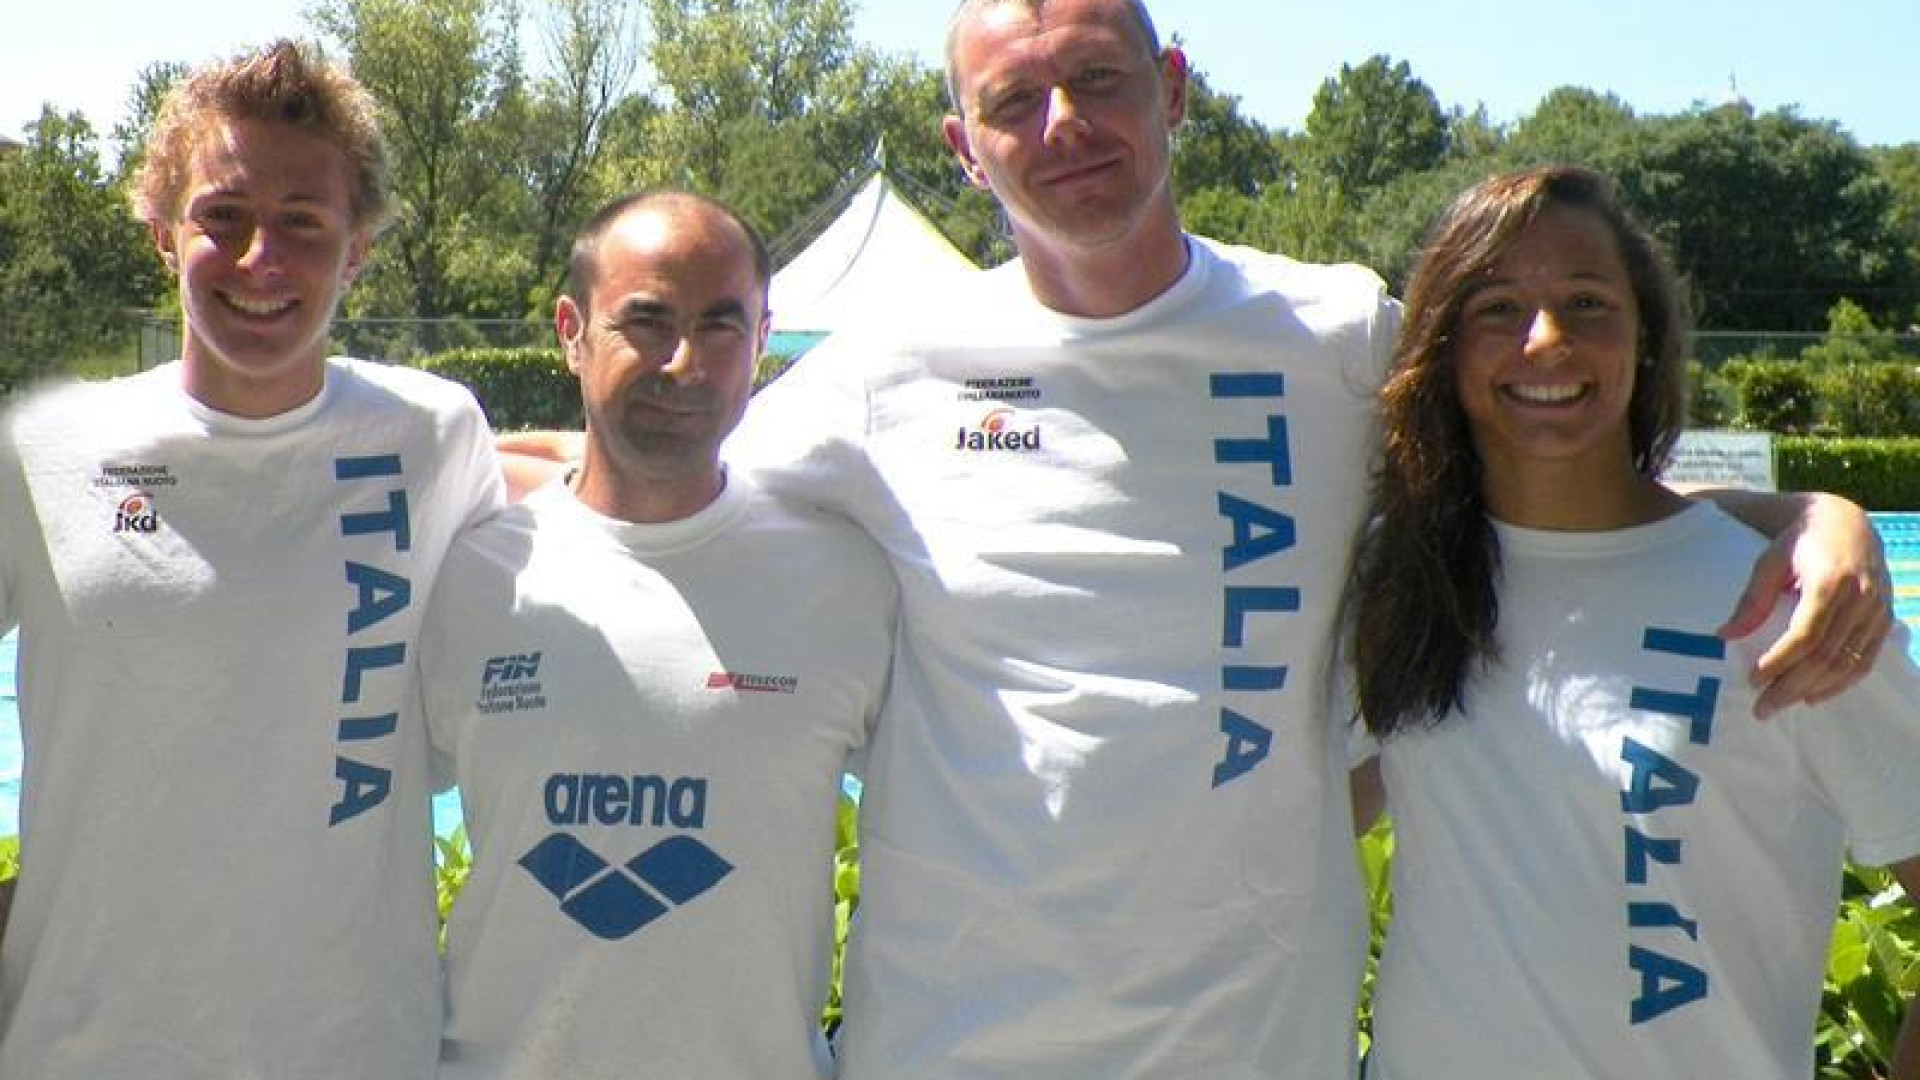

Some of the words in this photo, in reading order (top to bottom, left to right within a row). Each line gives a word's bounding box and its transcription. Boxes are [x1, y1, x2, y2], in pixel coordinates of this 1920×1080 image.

[955, 424, 1041, 452] Jaked
[328, 453, 412, 829] ITALIA
[482, 651, 543, 685] FIN
[1209, 371, 1301, 790] ITALIA
[543, 772, 708, 829] arena
[1619, 625, 1727, 1026] ITALIA
